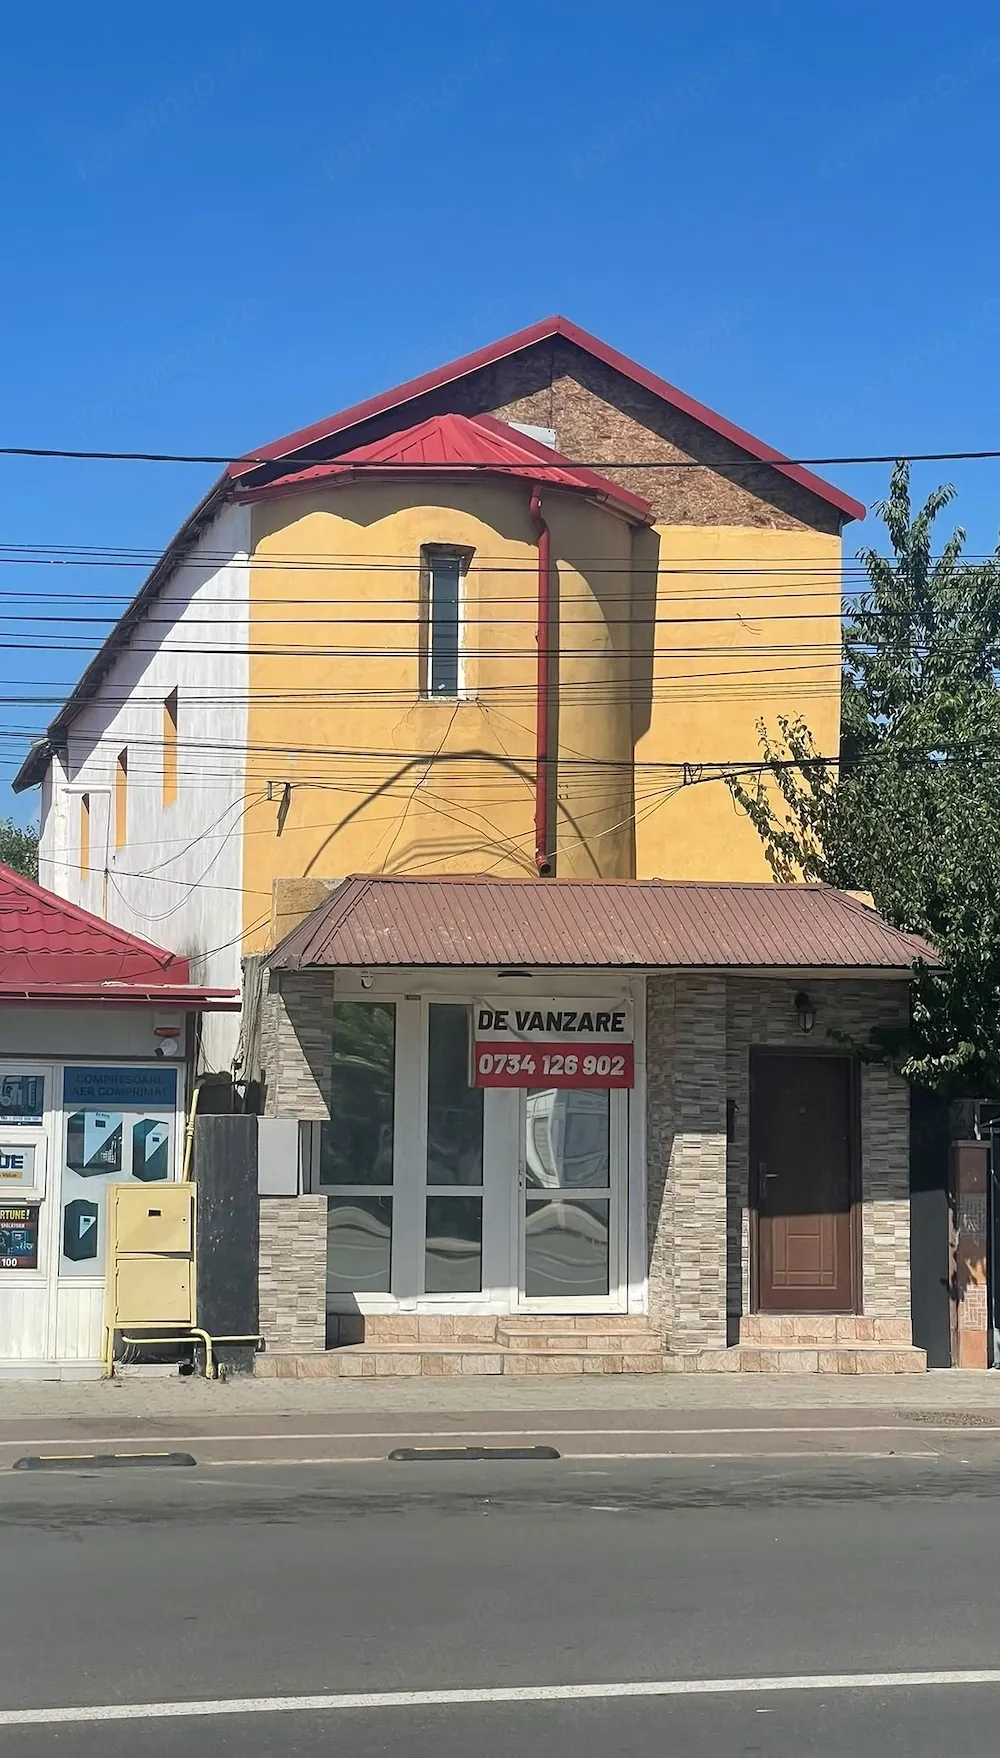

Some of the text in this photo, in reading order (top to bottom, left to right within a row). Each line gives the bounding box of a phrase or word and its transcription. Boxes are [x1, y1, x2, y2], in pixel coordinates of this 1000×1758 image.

[478, 1010, 626, 1032] DE VANZARE
[478, 1053, 626, 1076] 0734 126 902
[76, 1073, 164, 1085] COMPRESOARE
[72, 1086, 168, 1097] AER COMPRIMAT
[2, 1258, 18, 1267] 100
